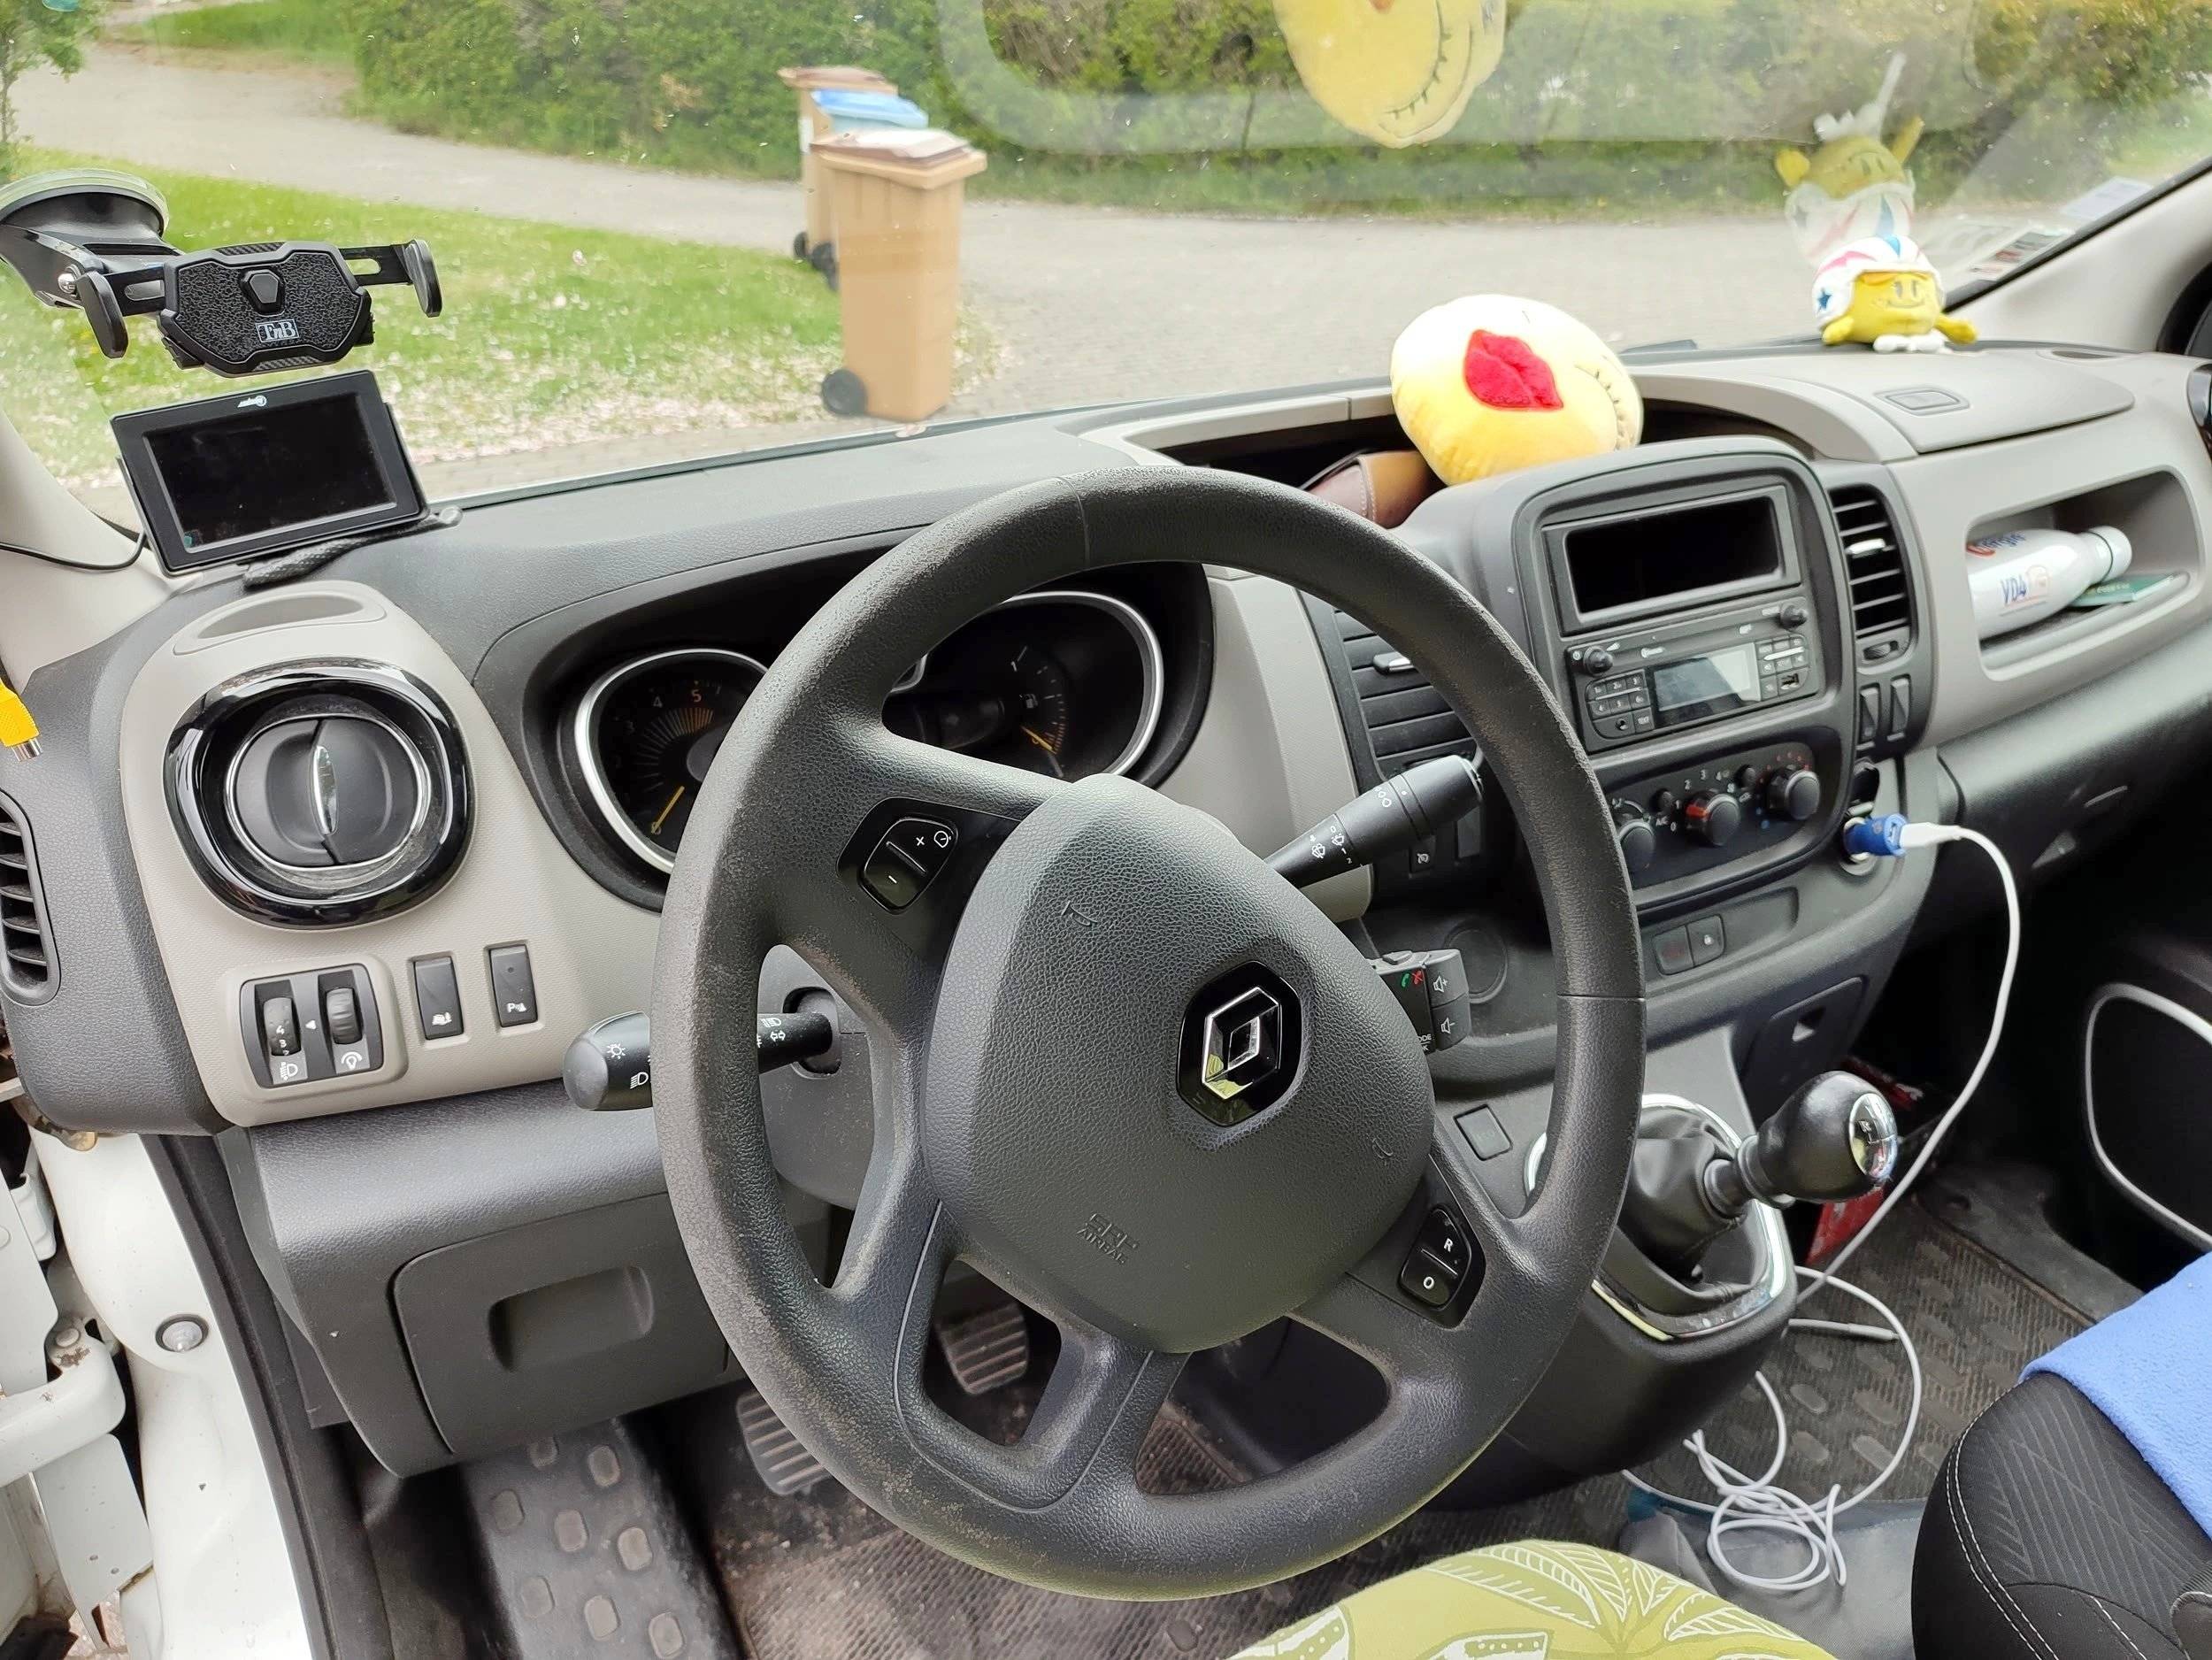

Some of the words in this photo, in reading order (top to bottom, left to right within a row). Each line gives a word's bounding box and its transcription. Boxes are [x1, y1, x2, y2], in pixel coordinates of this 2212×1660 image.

[653, 696, 663, 708] 4
[690, 689, 702, 703] 5
[276, 1025, 285, 1035] 4
[279, 1039, 288, 1049] 3
[1443, 1237, 1454, 1252] R
